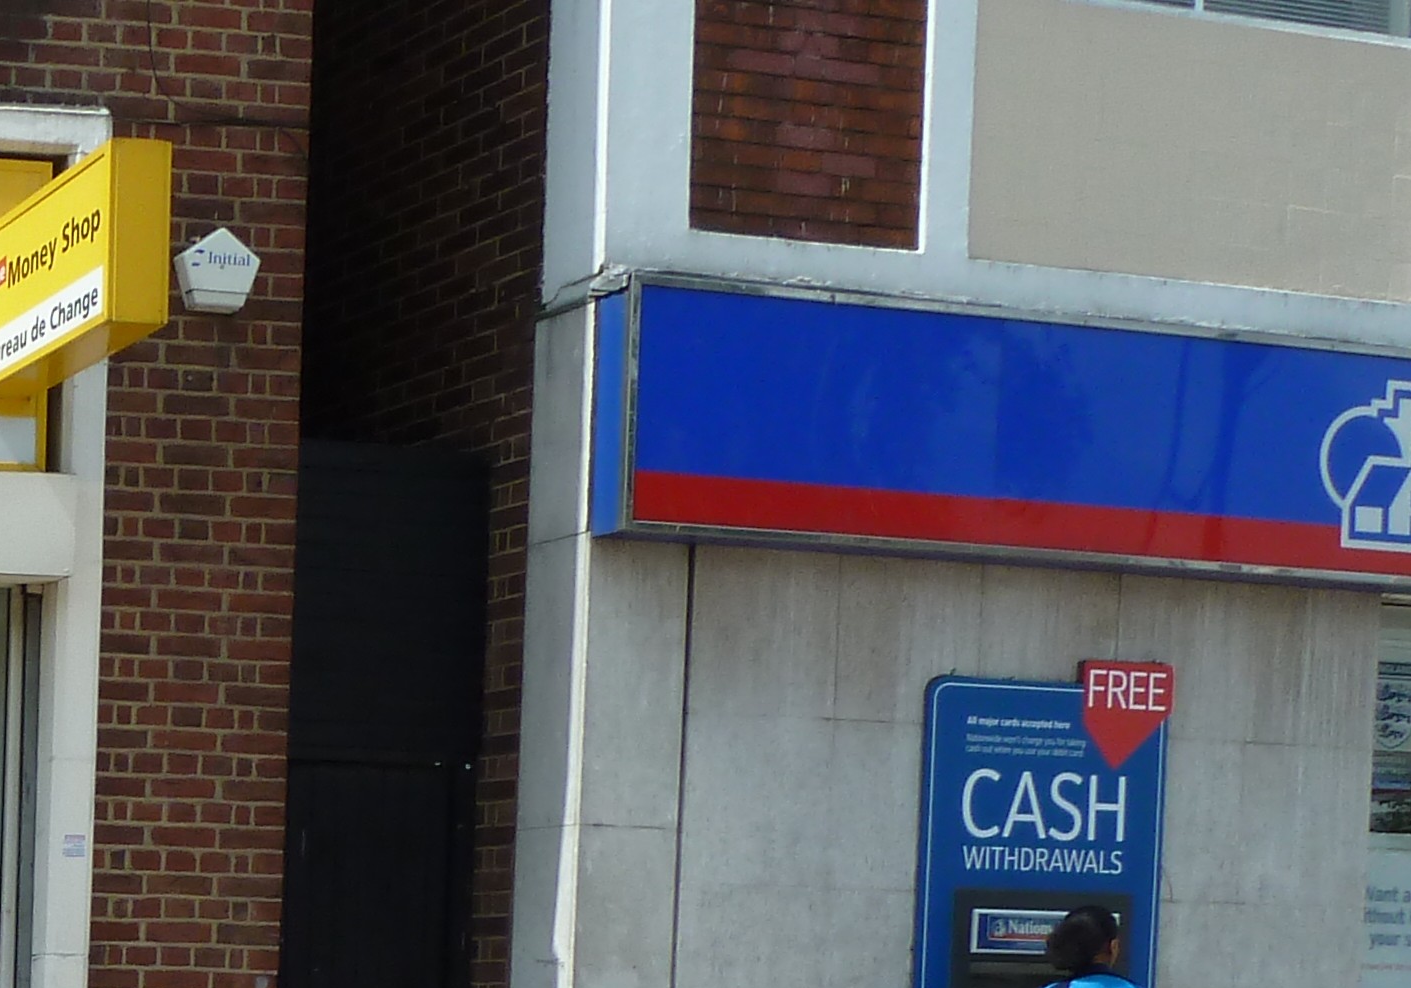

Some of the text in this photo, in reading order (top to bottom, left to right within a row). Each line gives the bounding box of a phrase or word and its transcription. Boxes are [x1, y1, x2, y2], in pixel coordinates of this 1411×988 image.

[7, 236, 57, 288] Money
[61, 208, 100, 253] Shop
[207, 250, 250, 267] Initial
[30, 316, 46, 343] de
[49, 286, 98, 329] Change
[1087, 669, 1168, 712] FREE
[962, 767, 1126, 842] CASH
[963, 845, 1123, 875] WITHDRAWALS
[1008, 920, 1052, 935] Nation
